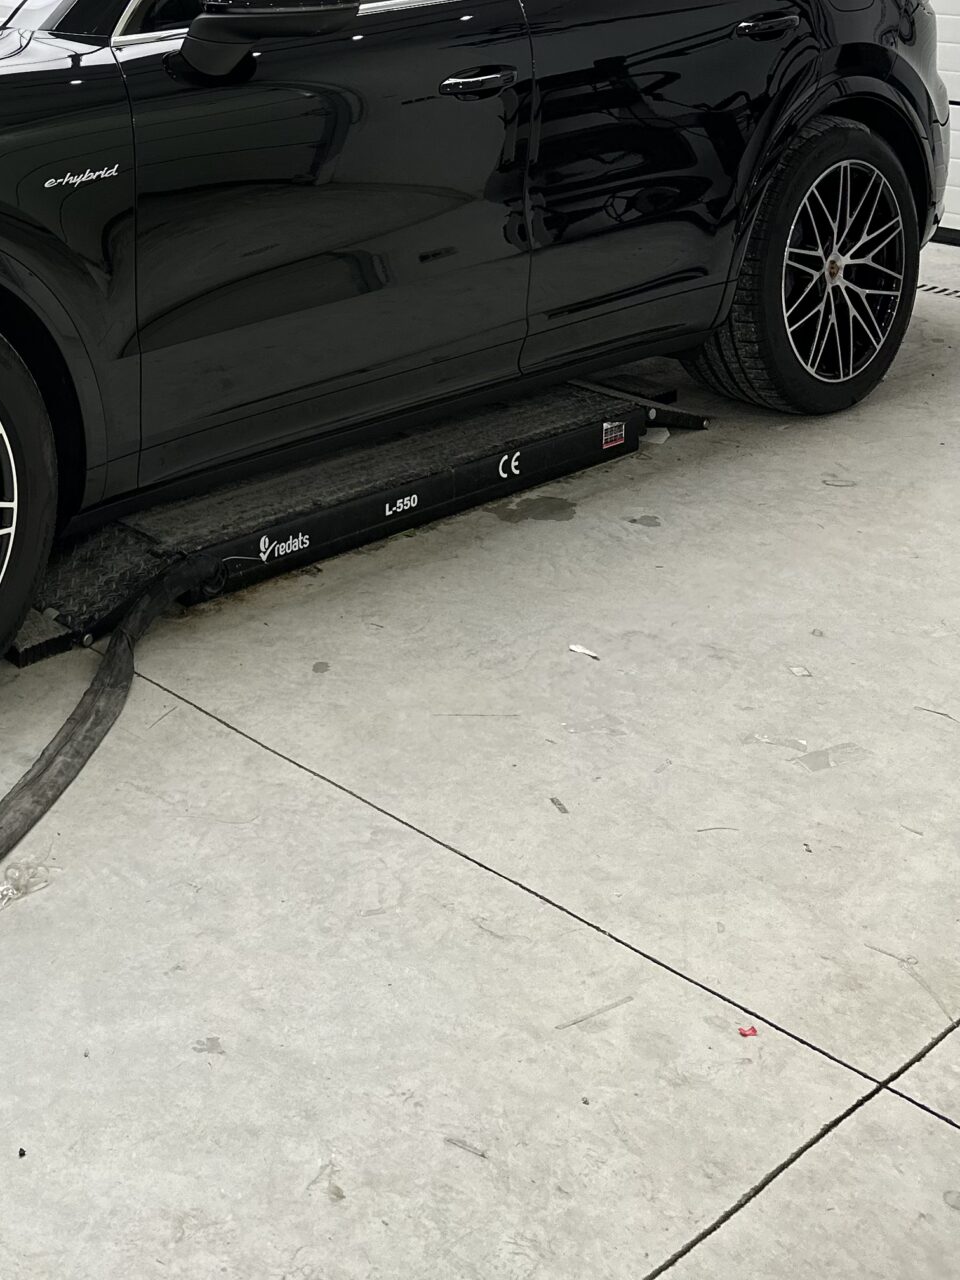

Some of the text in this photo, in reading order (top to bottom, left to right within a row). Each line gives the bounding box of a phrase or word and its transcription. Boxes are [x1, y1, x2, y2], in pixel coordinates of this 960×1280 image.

[44, 163, 119, 188] e-hybrid
[498, 451, 521, 478] CE
[385, 494, 418, 516] L-550
[274, 531, 310, 558] redats
